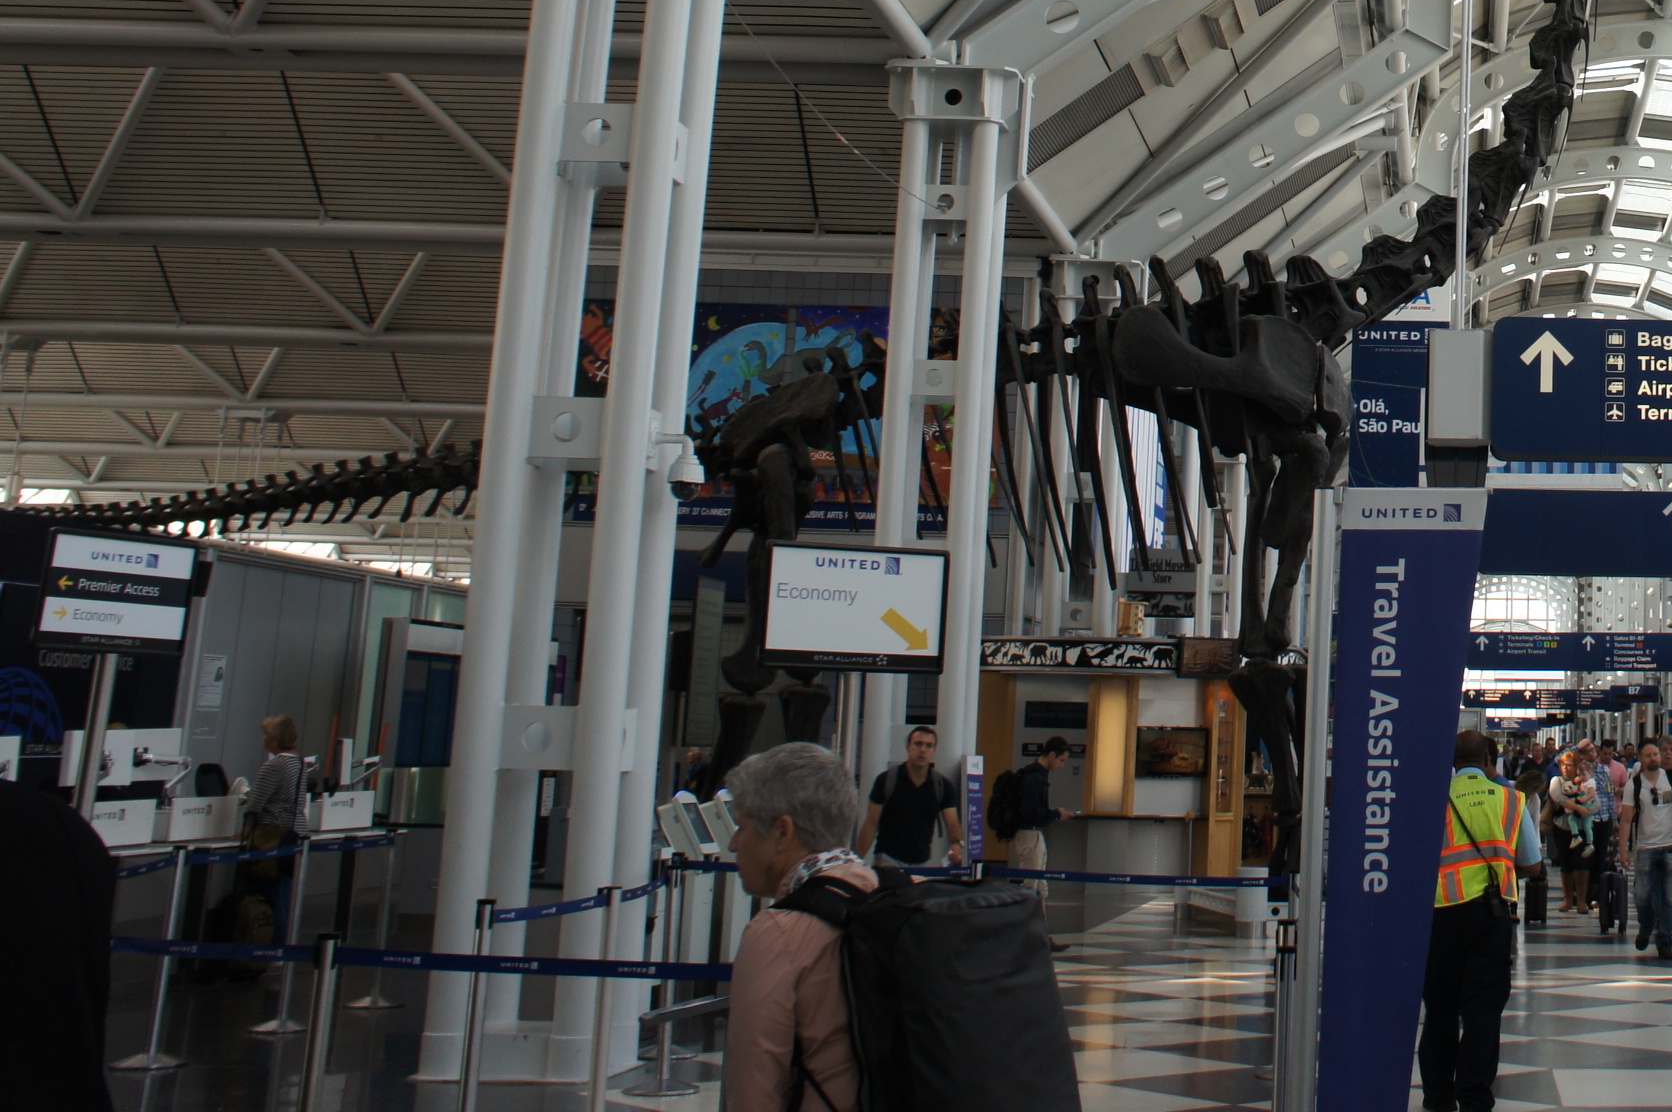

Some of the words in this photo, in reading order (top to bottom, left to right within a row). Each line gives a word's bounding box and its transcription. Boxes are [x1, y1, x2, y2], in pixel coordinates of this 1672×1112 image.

[1358, 330, 1421, 340] UNITED
[1359, 399, 1389, 416] Olá,
[1358, 418, 1388, 433] São
[1392, 419, 1420, 434] Pau
[826, 510, 844, 519] ARTS
[1361, 508, 1438, 519] UNITED
[91, 550, 144, 565] UNITED
[815, 557, 881, 571] UNITED
[1152, 572, 1172, 583] Store
[78, 578, 122, 594] Premier
[123, 582, 160, 597] Access
[777, 582, 859, 606] Economy
[73, 608, 124, 625] Economy
[1370, 558, 1406, 676] Travel
[40, 649, 94, 668] Customer
[813, 654, 834, 662] STAR
[835, 655, 874, 664] ALLIANCE
[1628, 686, 1641, 695] B7
[1363, 689, 1400, 893] Assistance
